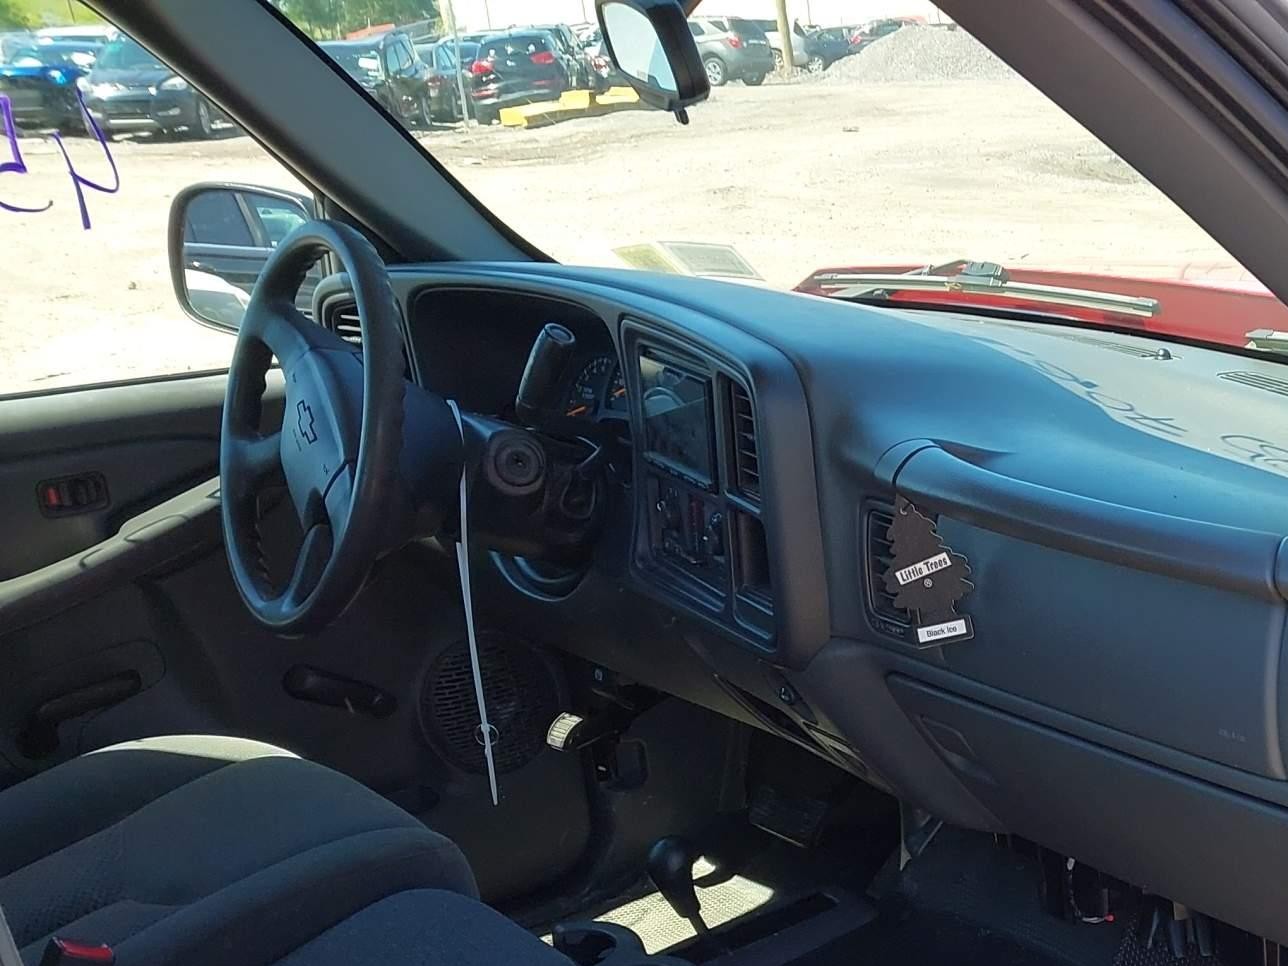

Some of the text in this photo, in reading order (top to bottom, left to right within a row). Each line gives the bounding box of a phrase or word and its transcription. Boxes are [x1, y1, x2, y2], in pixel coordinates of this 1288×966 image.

[899, 556, 949, 583] Little Trees
[926, 627, 946, 638] Black
